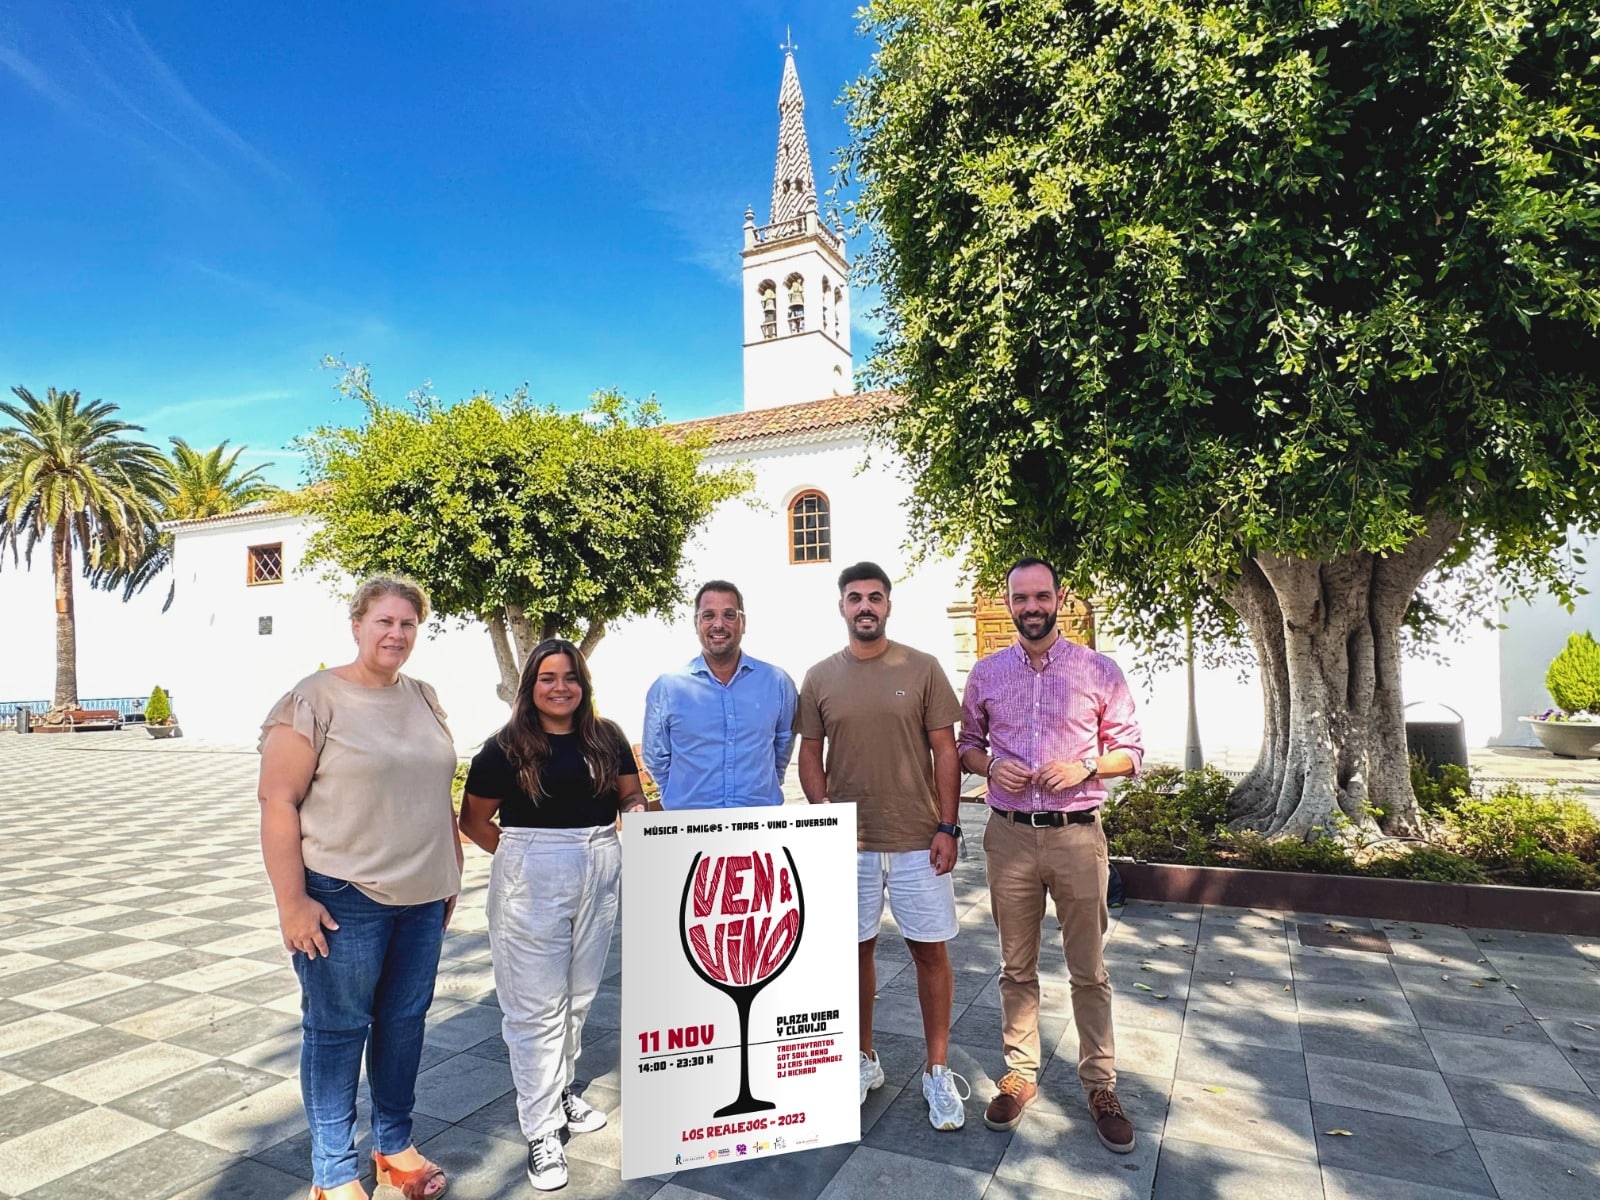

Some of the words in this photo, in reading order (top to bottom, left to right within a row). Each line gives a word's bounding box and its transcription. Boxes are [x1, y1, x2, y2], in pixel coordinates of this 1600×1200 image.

[643, 825, 678, 836] MÚSICA
[686, 824, 723, 834] AMIG@S
[731, 821, 759, 832] TAPAS
[767, 820, 788, 830] VINO
[795, 817, 838, 828] DIVERSIÓN
[693, 850, 775, 918] VEN
[779, 867, 793, 904] &
[776, 1013, 808, 1026] PLAZA
[810, 1009, 840, 1022] VIERA
[776, 1026, 784, 1037] Y
[786, 1021, 827, 1036] CLAVIJO
[638, 1030, 660, 1053] 11
[668, 1024, 715, 1050] NOV
[776, 1039, 835, 1053] TREINTAYTANTOS
[776, 1053, 790, 1061] GOT
[791, 1051, 809, 1060] SOUL
[810, 1048, 829, 1057] BAND
[638, 1060, 667, 1073] 14:00
[676, 1055, 705, 1069] 23:30
[706, 1054, 714, 1065] H
[777, 1062, 787, 1070] DJ
[787, 1060, 803, 1068] CRIS
[777, 1070, 787, 1078] DJ
[787, 1066, 817, 1077] RICHARD
[681, 1128, 705, 1142] LOS
[706, 1117, 769, 1138] REALEJOS
[777, 1112, 806, 1127] 2023
